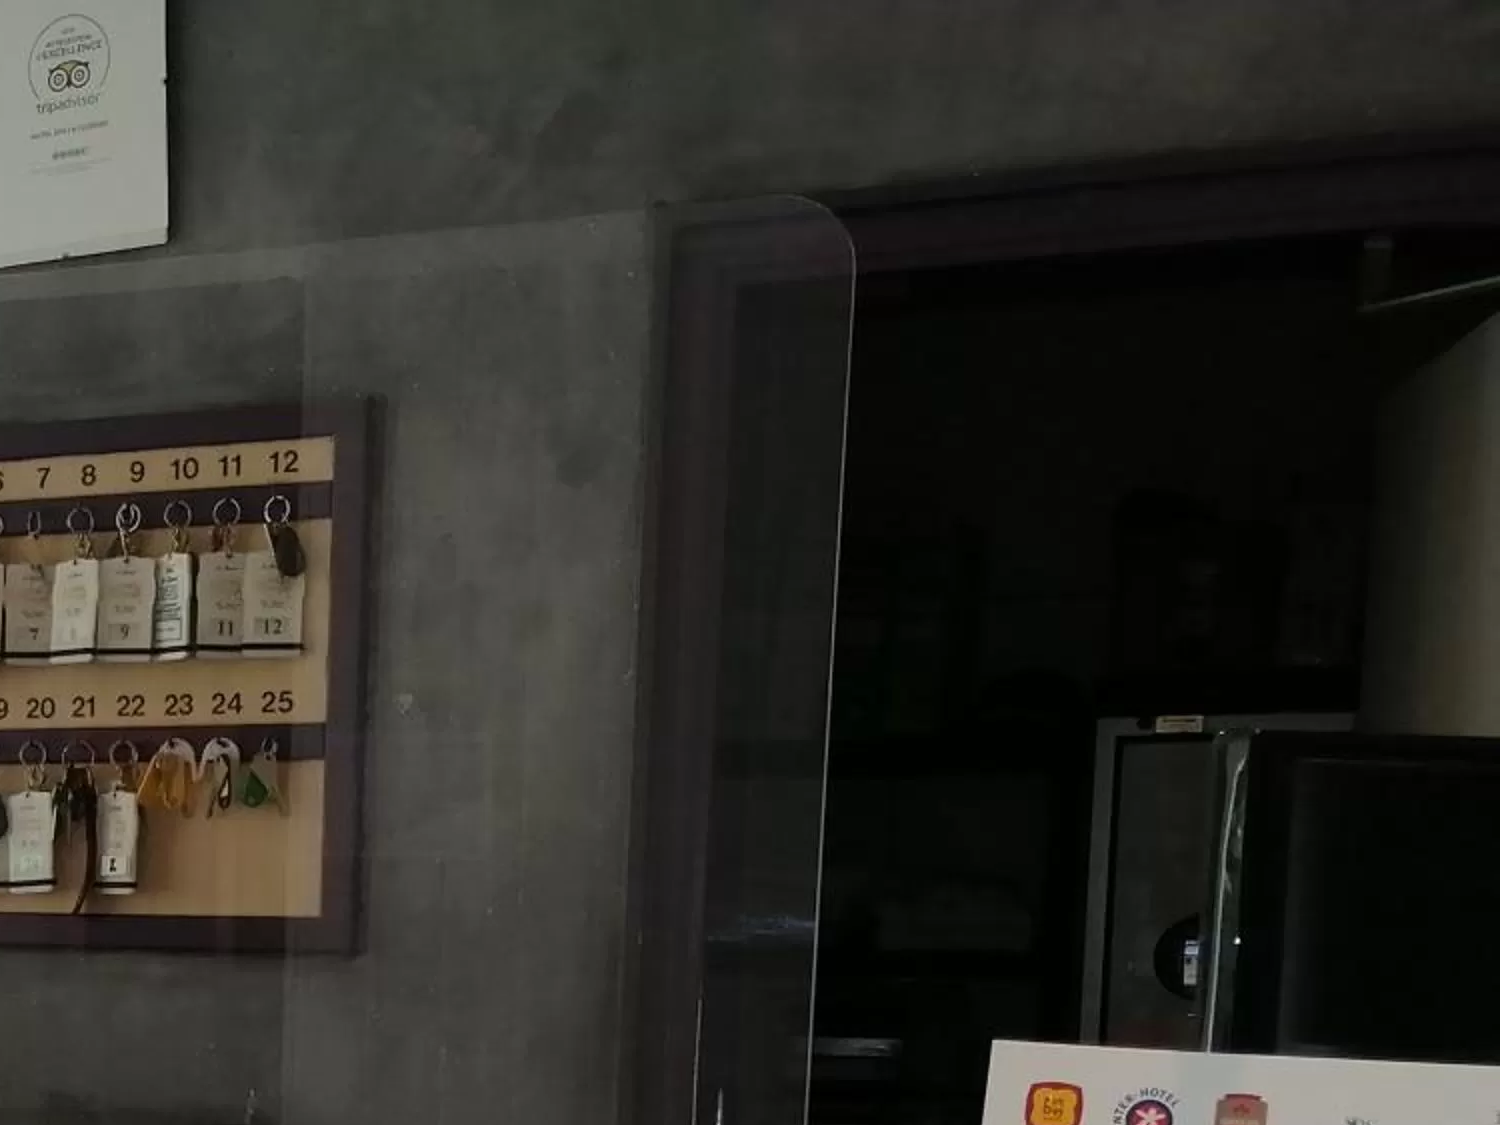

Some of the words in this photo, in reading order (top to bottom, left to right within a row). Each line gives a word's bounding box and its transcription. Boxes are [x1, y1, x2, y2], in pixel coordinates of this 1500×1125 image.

[37, 467, 51, 489] 7
[81, 464, 96, 486] 8
[131, 461, 145, 483] 9
[170, 457, 199, 480] 10
[219, 454, 242, 477] 11
[269, 450, 299, 474] 12
[217, 620, 234, 637] 11
[264, 618, 283, 635] 12
[26, 697, 56, 720] 20
[72, 696, 96, 718] 21
[117, 695, 146, 717] 22
[165, 693, 194, 716] 23
[212, 692, 243, 715] 24
[262, 690, 294, 714] 25
